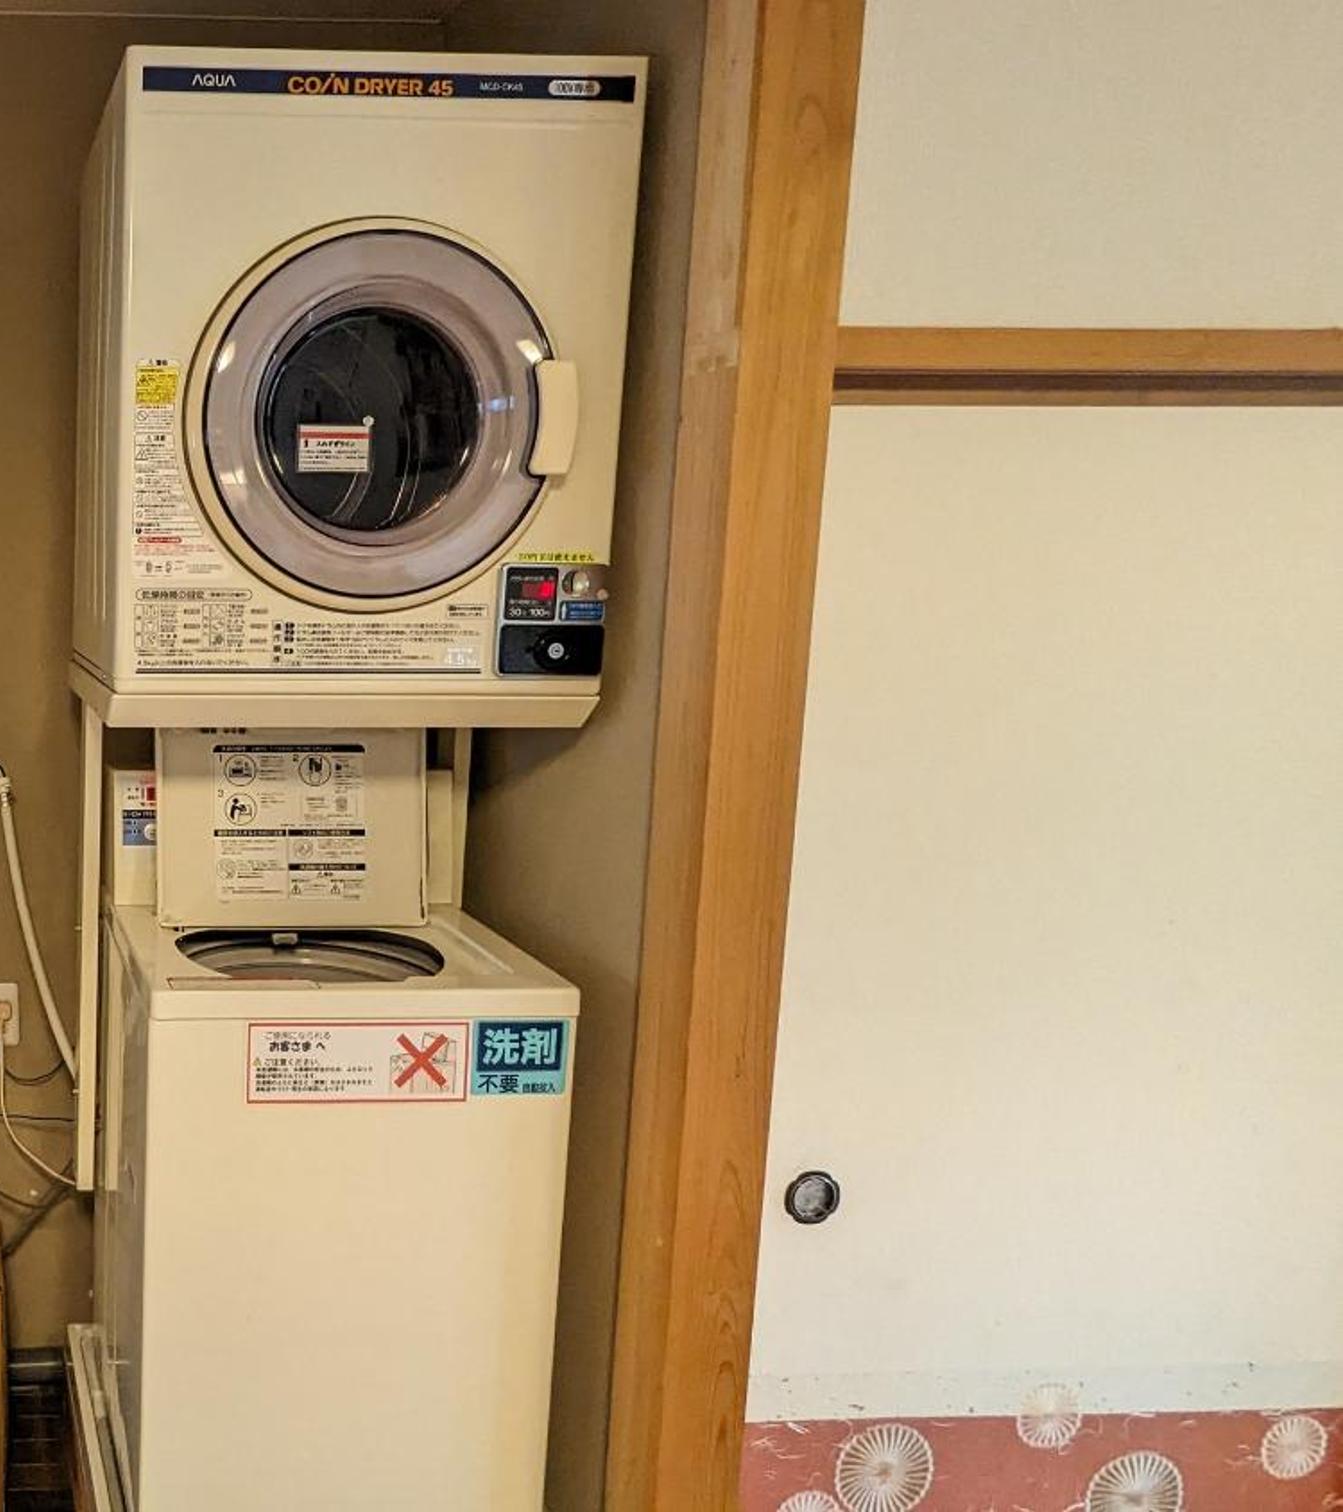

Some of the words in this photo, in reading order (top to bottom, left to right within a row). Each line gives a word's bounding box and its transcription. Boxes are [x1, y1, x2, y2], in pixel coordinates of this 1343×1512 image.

[191, 73, 237, 87] AQUA
[287, 72, 350, 94] COIN
[355, 77, 424, 96] DRYER
[428, 79, 455, 97] 45
[482, 1027, 558, 1065] 洗剤
[478, 1074, 520, 1094] 不要
[522, 1082, 556, 1094] 自動投入
